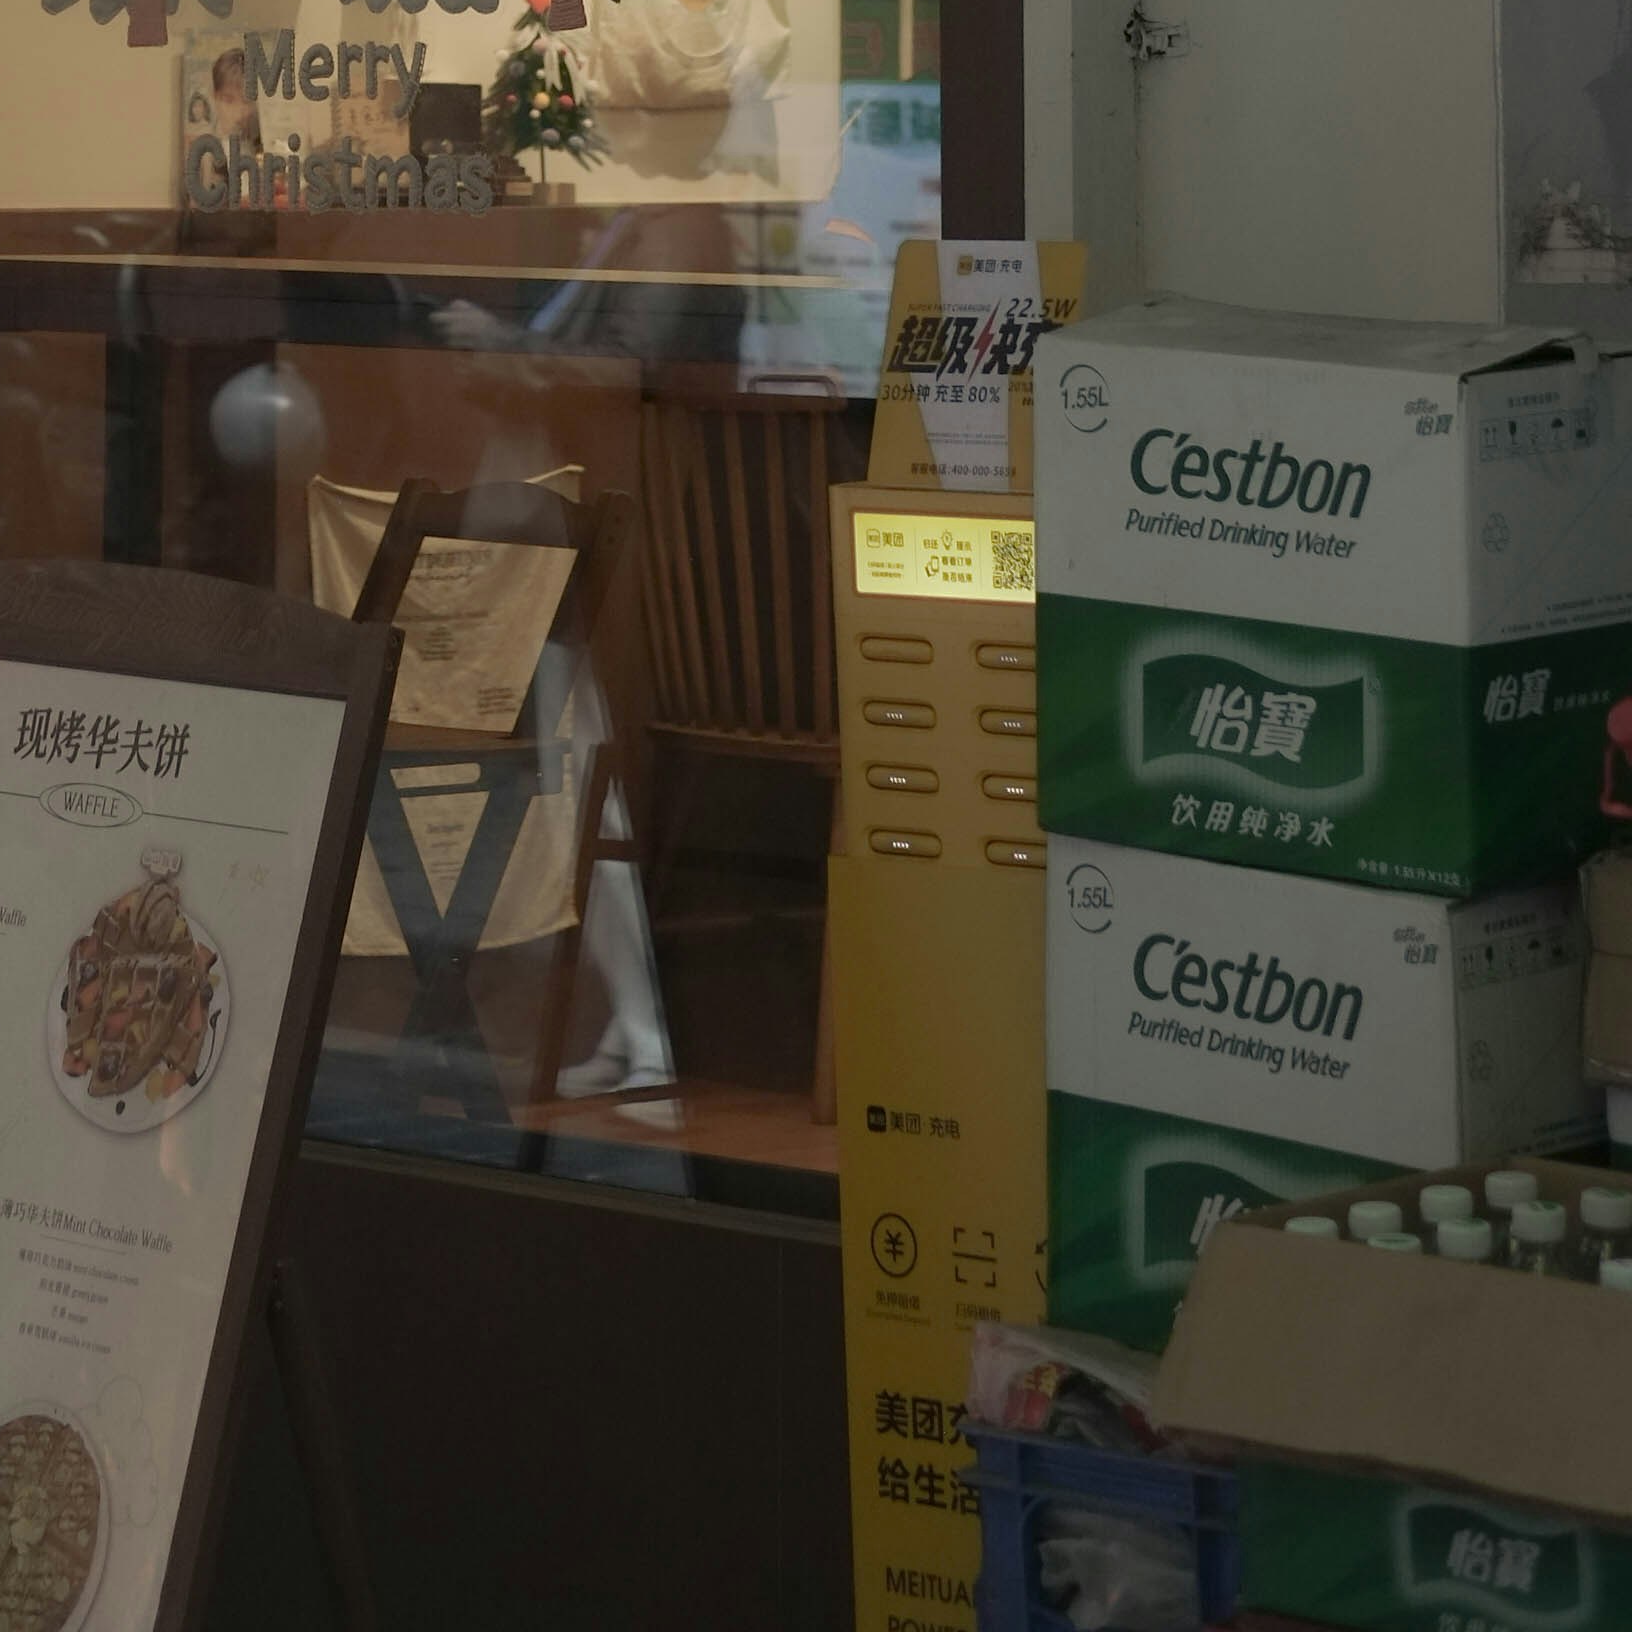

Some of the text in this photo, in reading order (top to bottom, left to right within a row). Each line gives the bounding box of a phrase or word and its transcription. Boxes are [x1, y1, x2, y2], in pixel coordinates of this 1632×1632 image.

[244, 29, 427, 119] Merry
[185, 134, 496, 216] Christmas
[1006, 298, 1078, 318] 22.5W
[968, 385, 1001, 403] 80%
[1061, 386, 1109, 409] 1.55L
[1126, 508, 1358, 559] Purified Drinking Water
[14, 708, 190, 778] 现烤华夫饼
[1189, 683, 1317, 763] 怡寶
[64, 791, 121, 818] WAFFLE
[1171, 793, 1335, 848] 饮用纯净水
[1068, 886, 1113, 909] 1.55L
[1128, 1012, 1350, 1081] Purified Drinking Water
[1447, 1528, 1541, 1593] 怡寶
[886, 1567, 976, 1612] MEITUA
